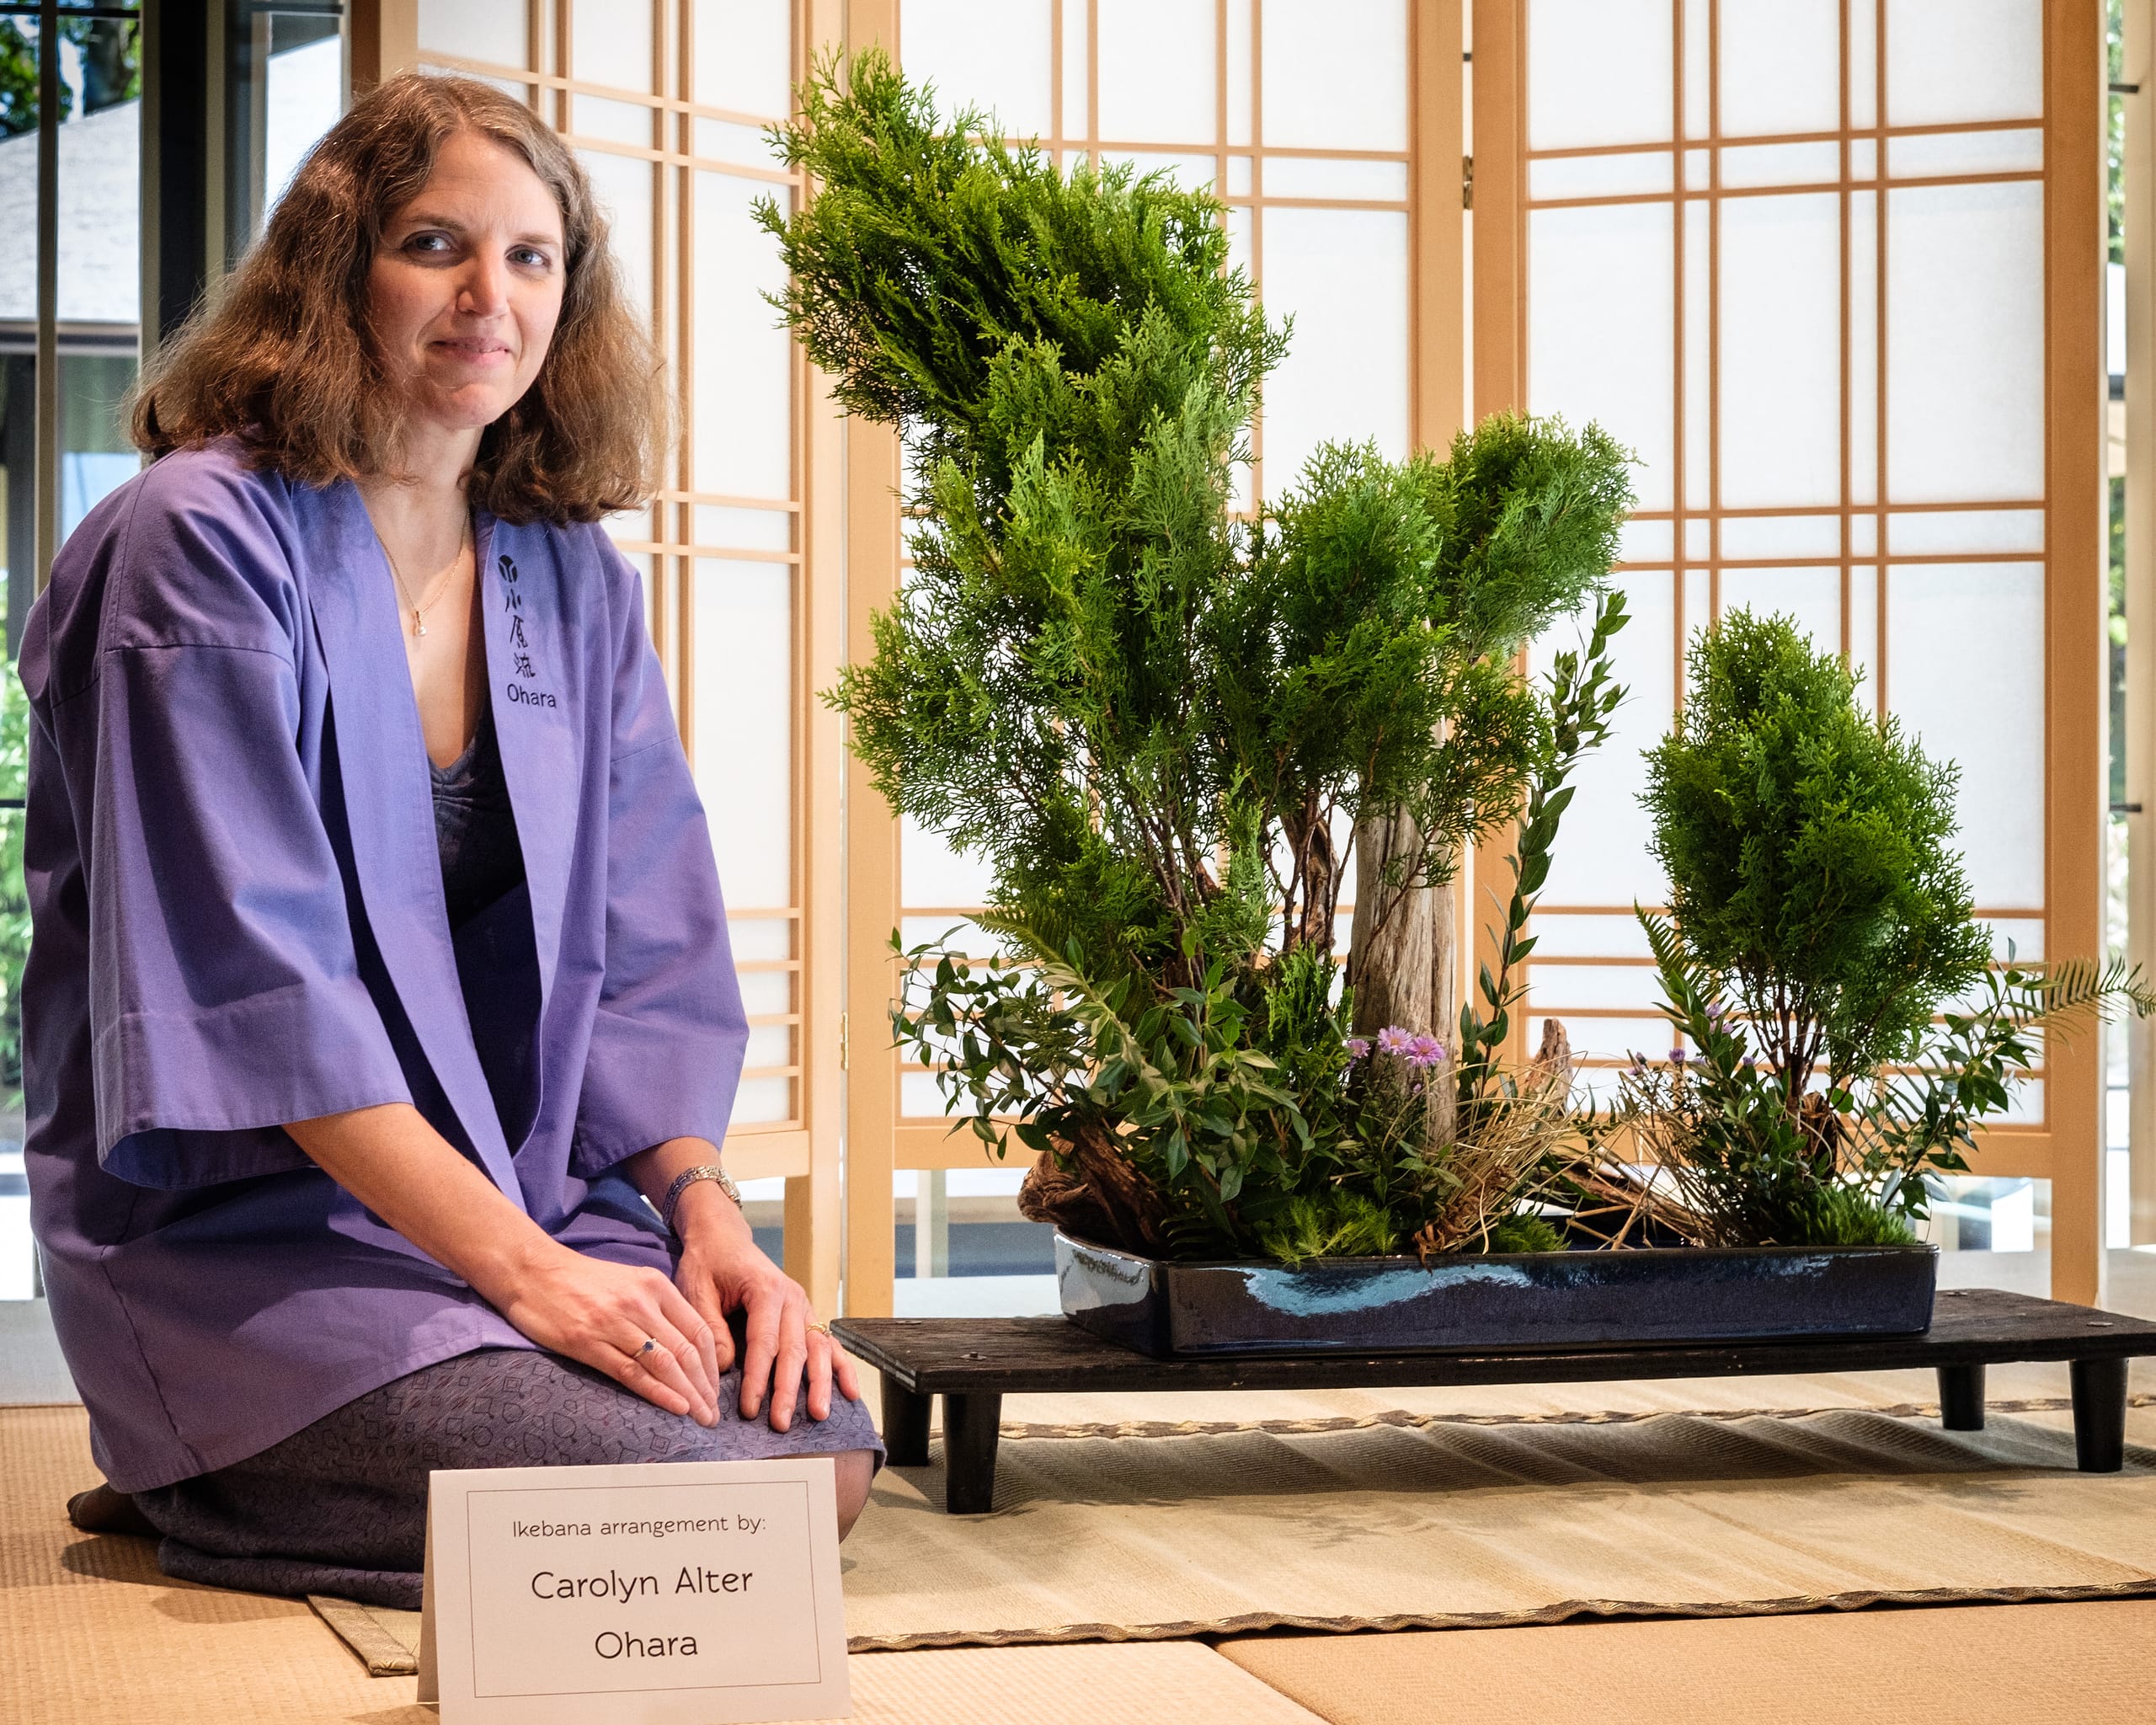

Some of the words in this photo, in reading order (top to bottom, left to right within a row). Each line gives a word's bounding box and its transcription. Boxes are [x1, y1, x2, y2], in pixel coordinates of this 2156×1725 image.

[505, 589, 536, 678] 小原流
[507, 683, 557, 708] Ohara
[512, 1519, 592, 1538] Ikebana
[600, 1516, 728, 1538] arrangement
[736, 1514, 767, 1535] by:
[531, 1569, 659, 1605] Carolyn
[675, 1567, 753, 1595] Alter
[595, 1631, 698, 1659] Ohara
